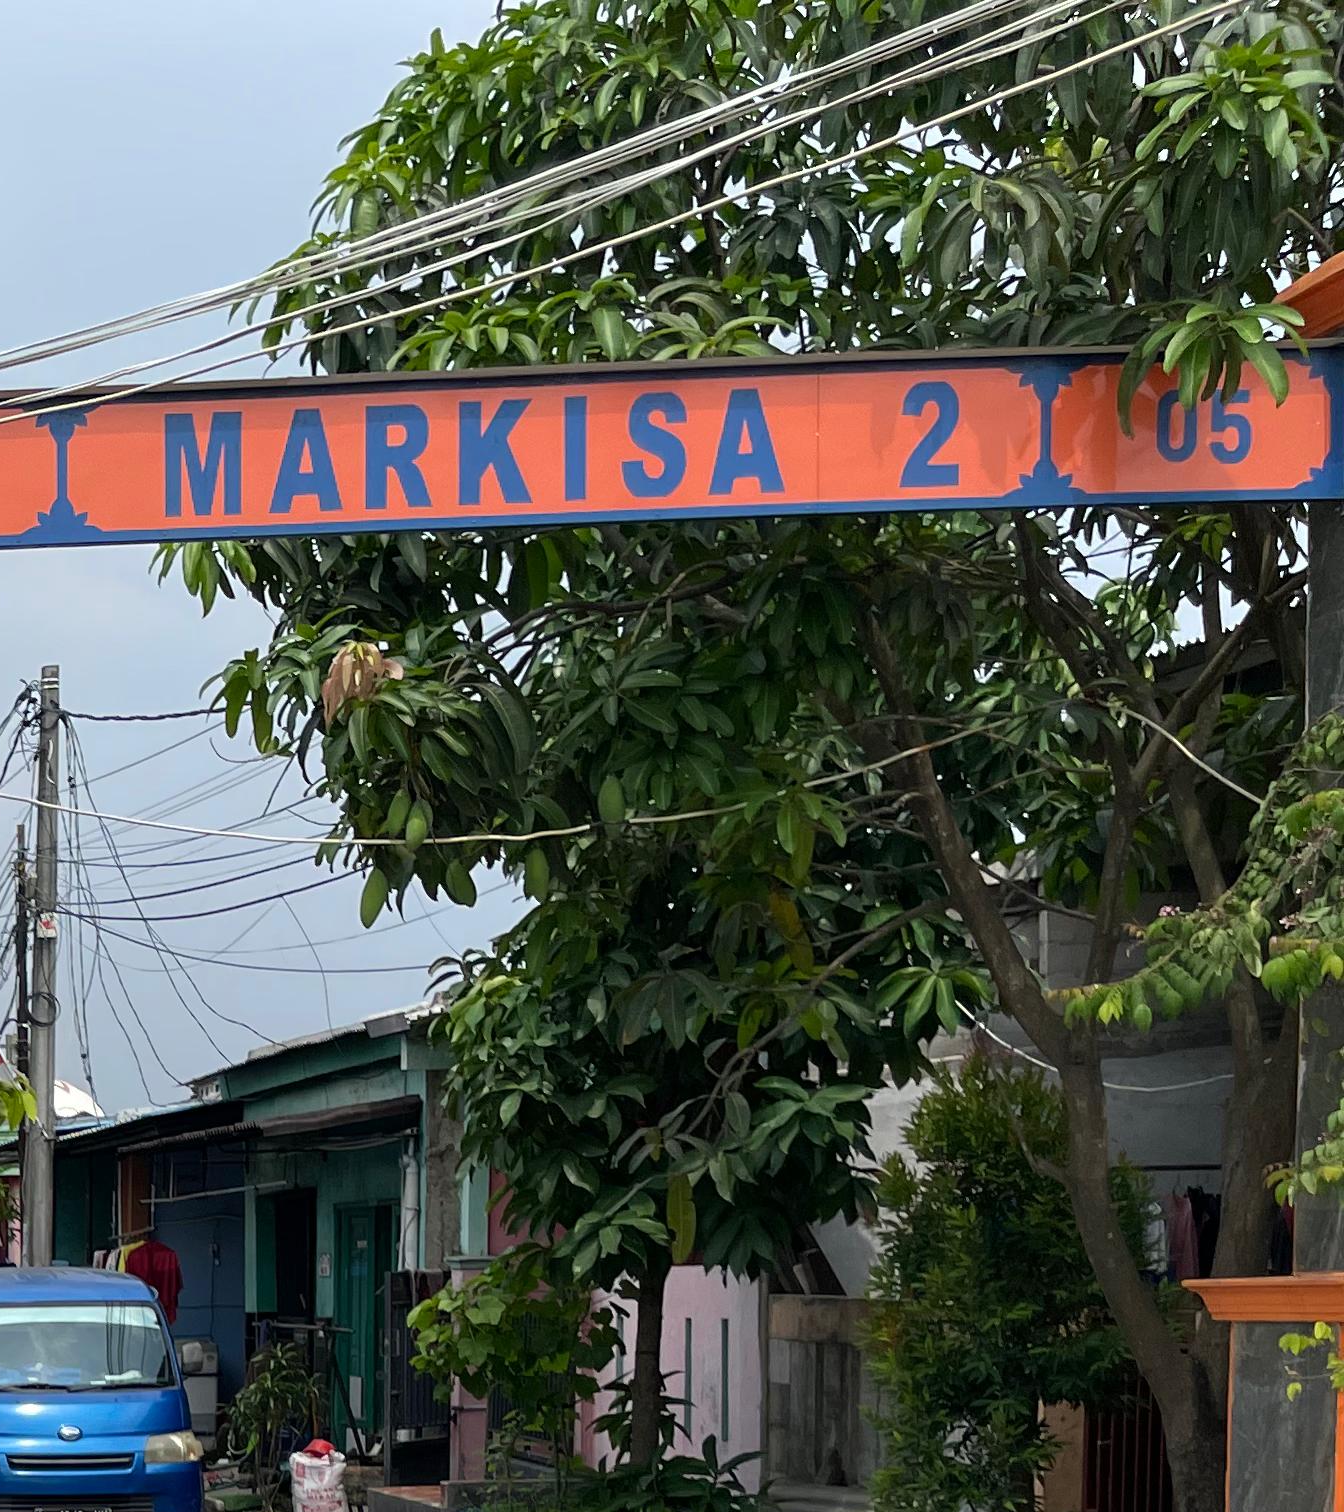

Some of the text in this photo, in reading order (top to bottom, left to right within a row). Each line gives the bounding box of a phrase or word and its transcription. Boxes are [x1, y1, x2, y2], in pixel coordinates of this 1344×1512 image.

[166, 389, 785, 519] MARKISA
[902, 382, 960, 488] 2
[1157, 389, 1251, 464] 05
